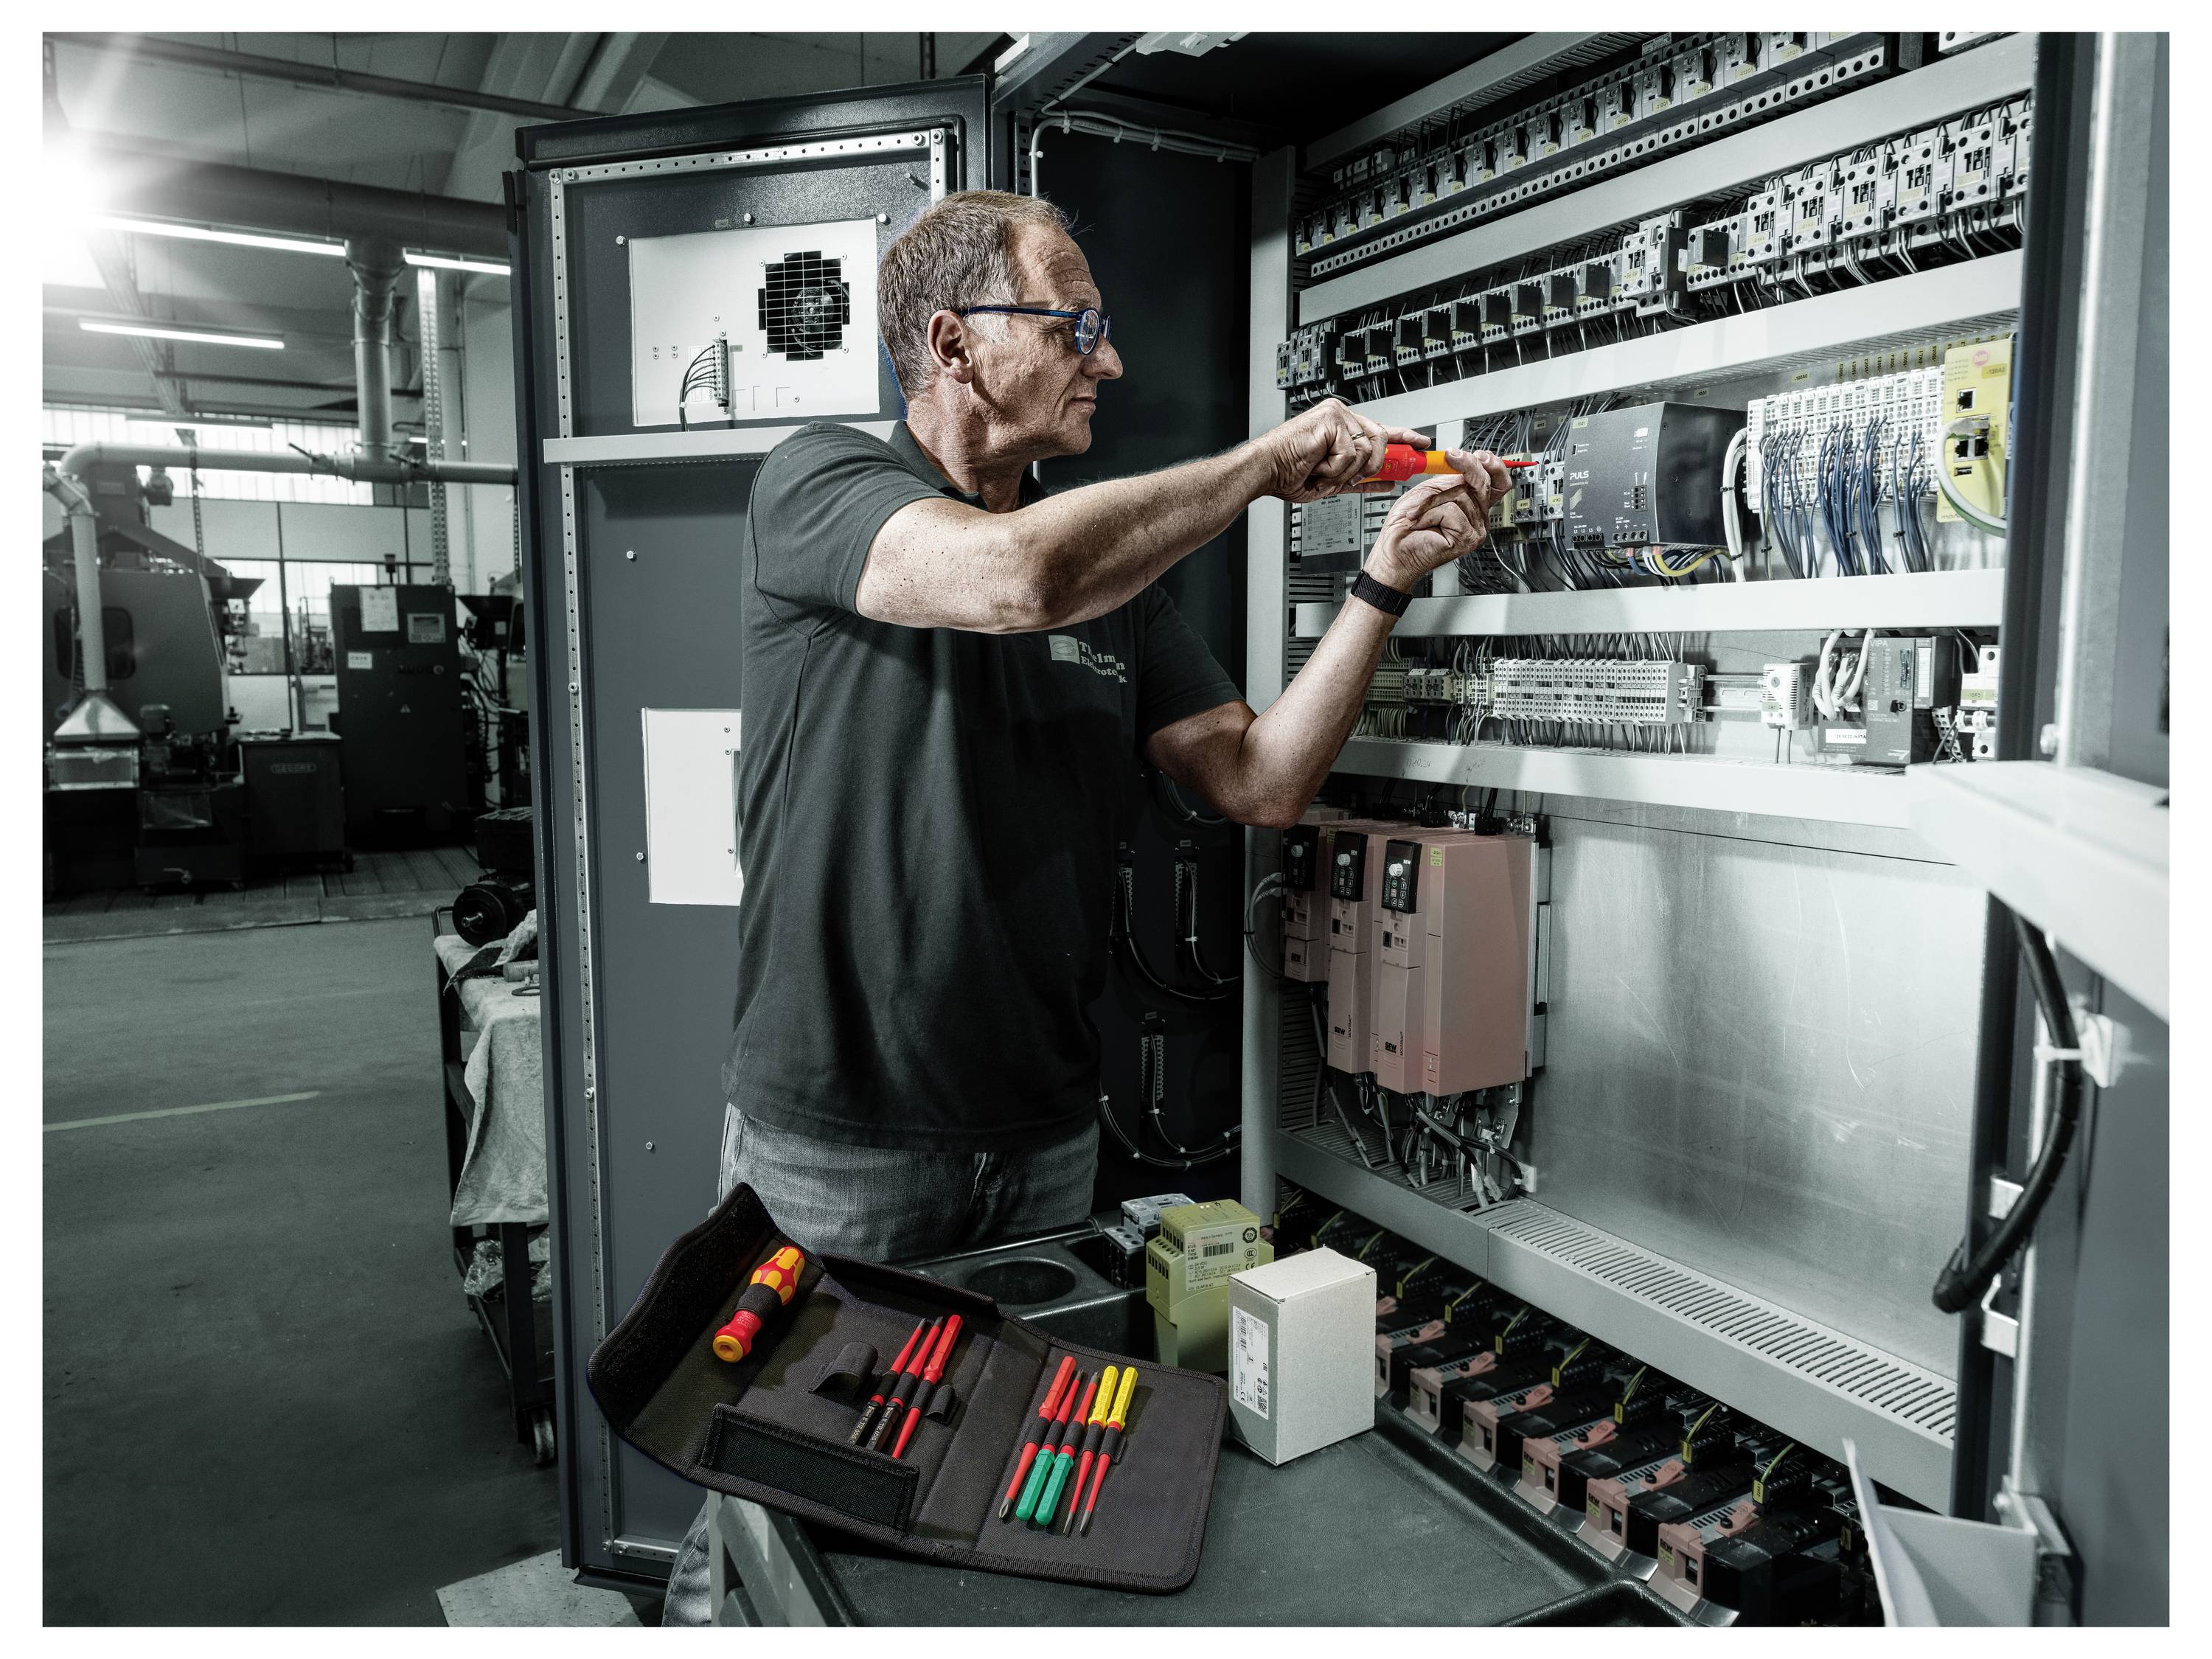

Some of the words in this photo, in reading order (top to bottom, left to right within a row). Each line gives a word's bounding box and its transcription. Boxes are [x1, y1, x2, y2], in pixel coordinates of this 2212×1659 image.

[1570, 470, 1589, 480] PULS
[1334, 1026, 1346, 1035] SEW
[1385, 1041, 1397, 1051] SEW
[1588, 1492, 1600, 1506] SEW
[1660, 1538, 1673, 1552] SEW
